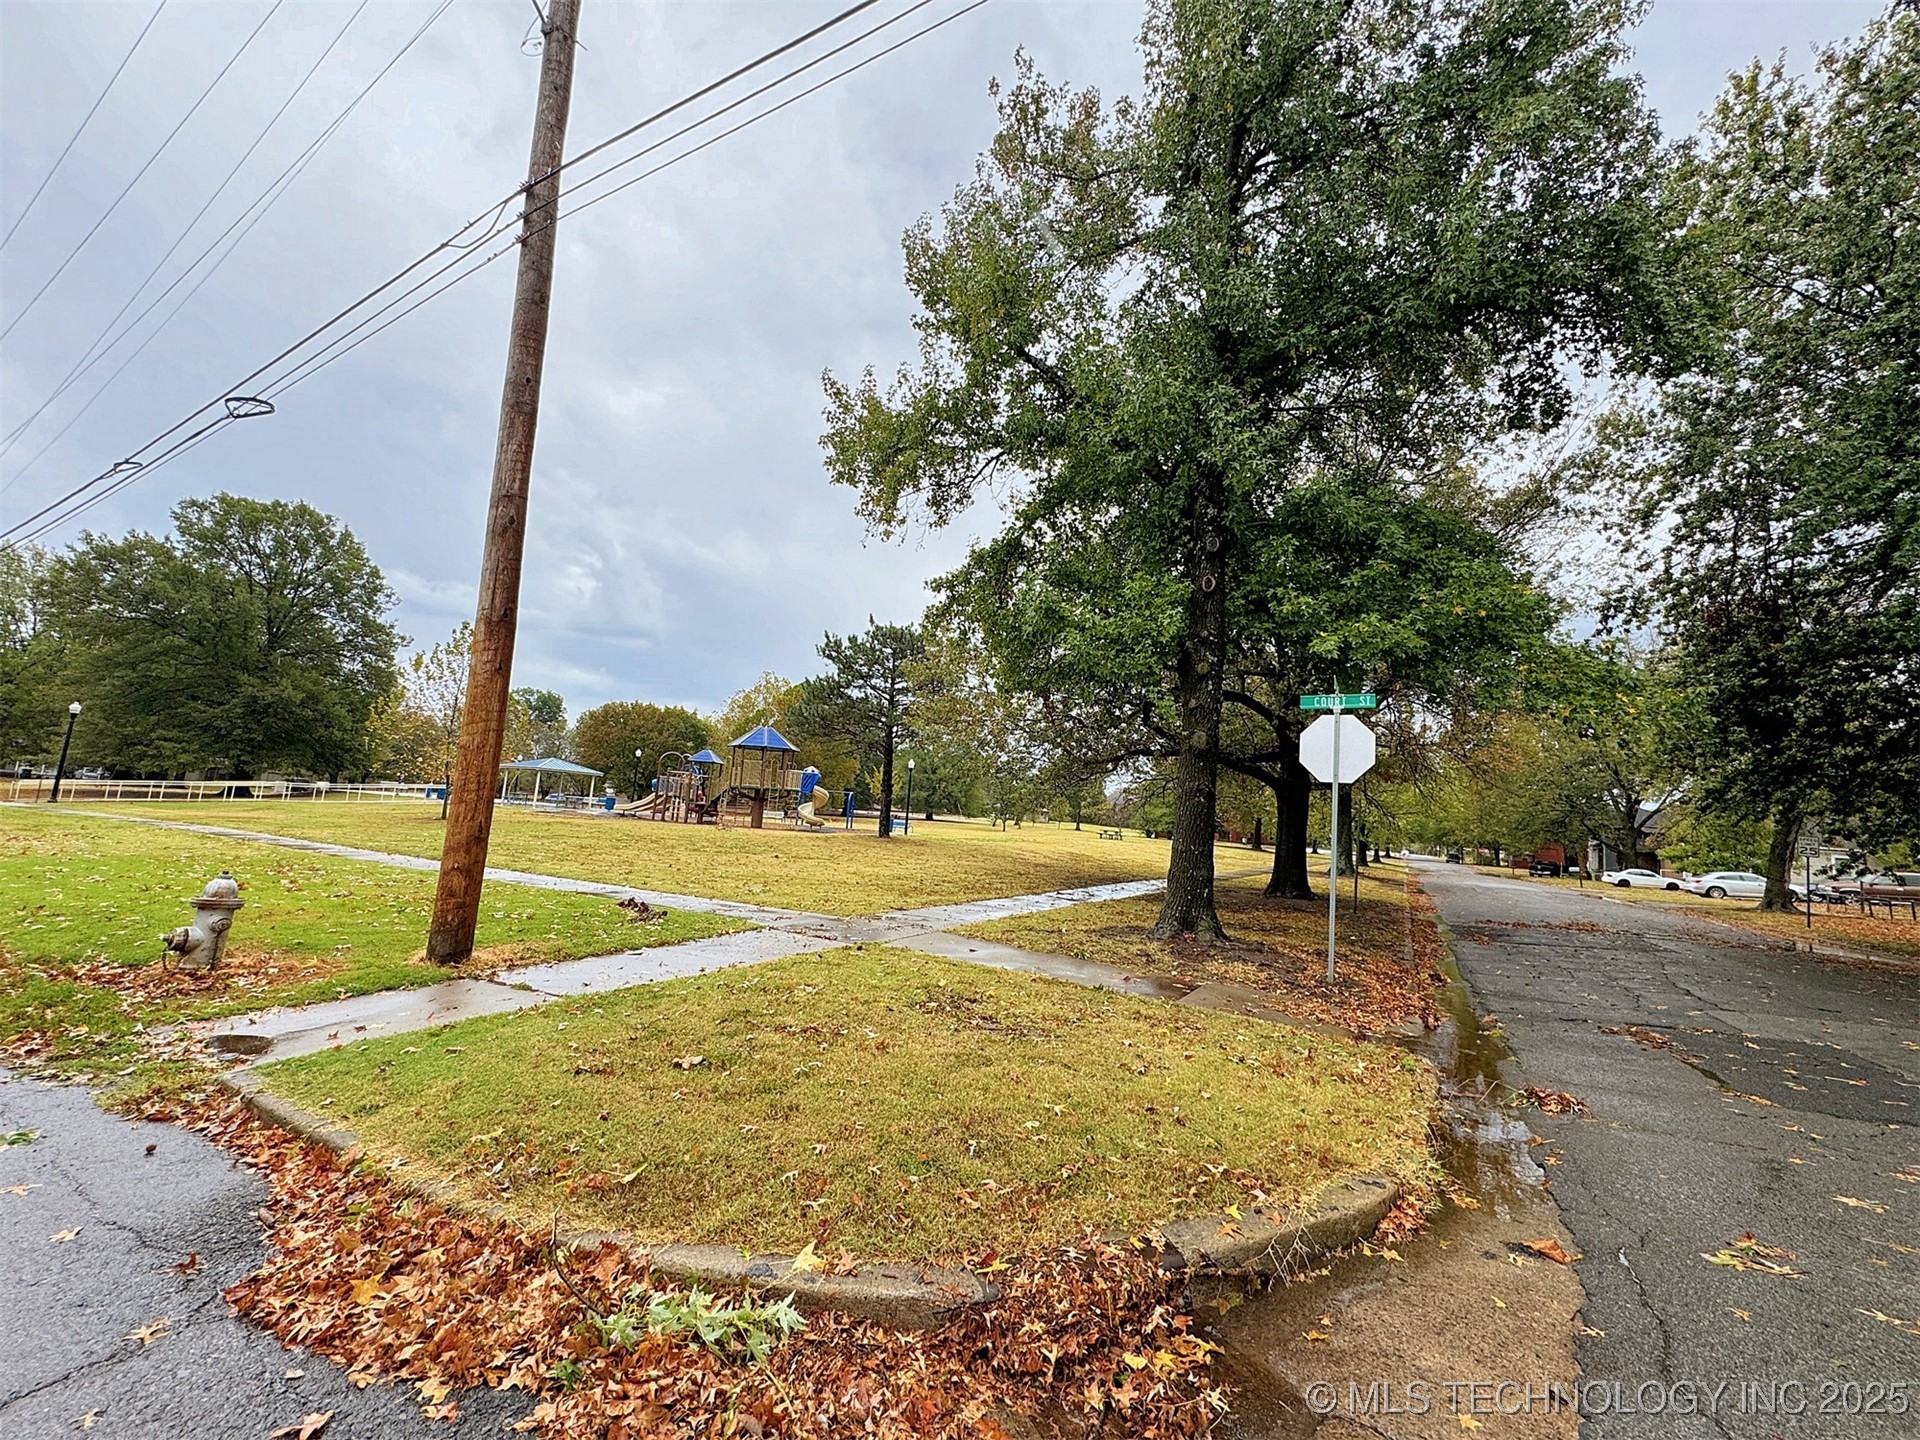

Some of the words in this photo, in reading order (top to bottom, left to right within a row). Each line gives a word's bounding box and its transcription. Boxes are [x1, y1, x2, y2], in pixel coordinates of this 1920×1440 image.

[1314, 697, 1346, 707] COURT
[1359, 696, 1371, 706] ST
[1799, 846, 1817, 855] 25
